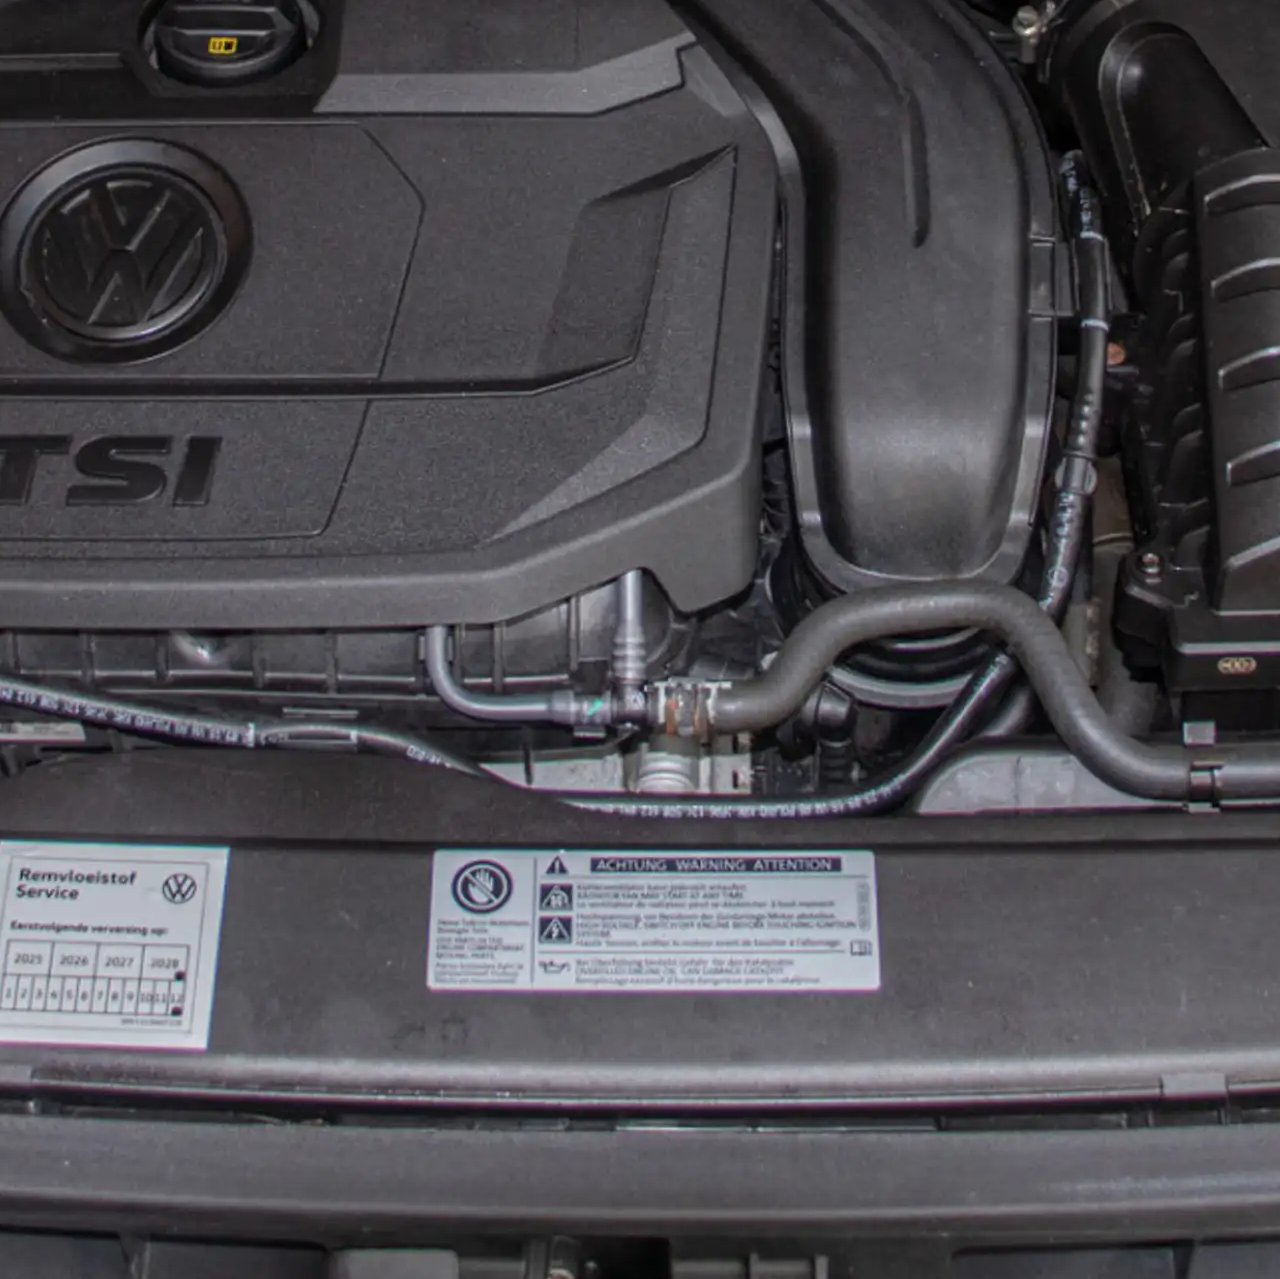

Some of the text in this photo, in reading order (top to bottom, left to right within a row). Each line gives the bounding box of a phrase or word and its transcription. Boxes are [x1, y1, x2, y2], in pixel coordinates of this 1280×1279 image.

[596, 858, 832, 870] ACHTUNG WARNING ATTENTION
[19, 868, 137, 886] Remvloeistof
[16, 884, 79, 900] Service
[10, 921, 89, 934] Eerstvolgende
[14, 953, 180, 969] 2025 2026 2027 2028
